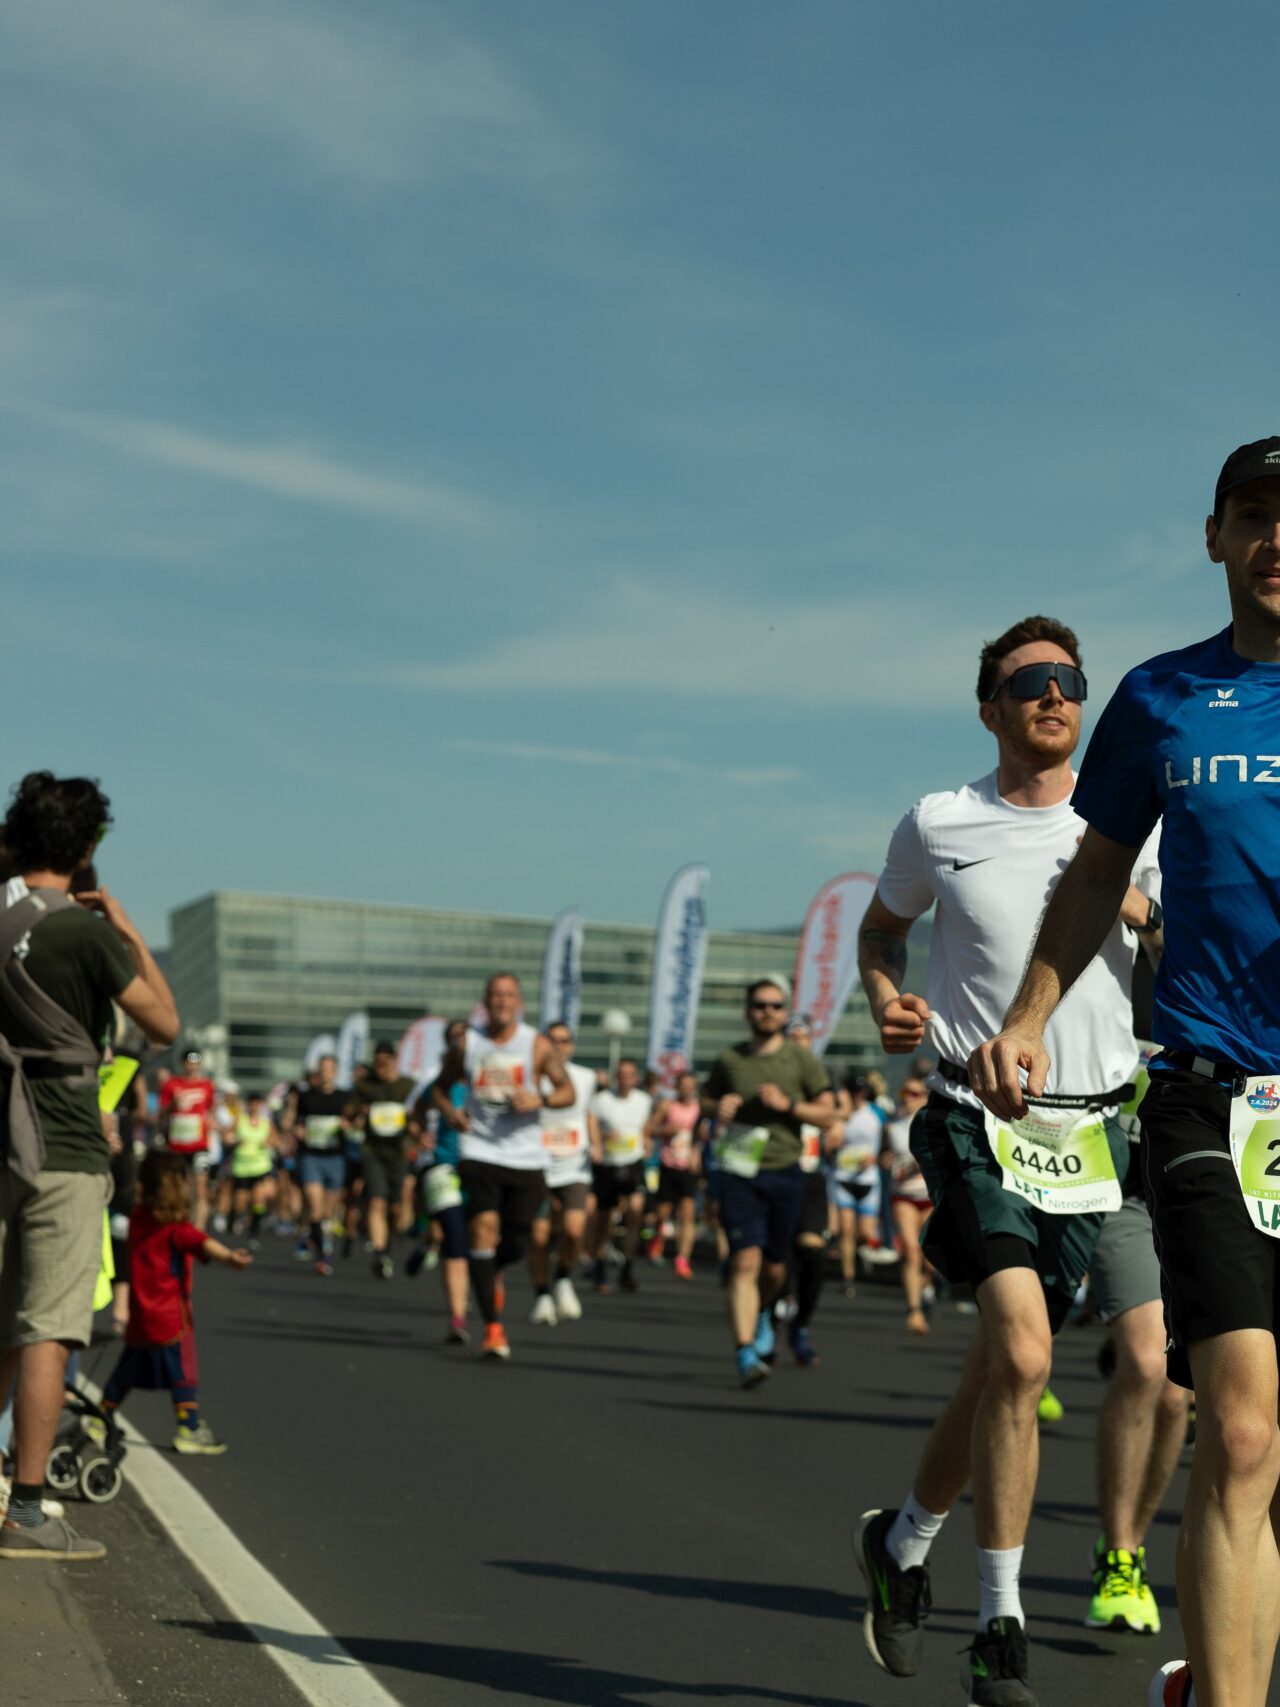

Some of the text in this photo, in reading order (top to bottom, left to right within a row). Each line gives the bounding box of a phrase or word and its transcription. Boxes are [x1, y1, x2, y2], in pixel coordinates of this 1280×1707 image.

[1208, 700, 1239, 708] erima
[1011, 1146, 1081, 1177] 4440
[1048, 1197, 1108, 1210] Nitrogen
